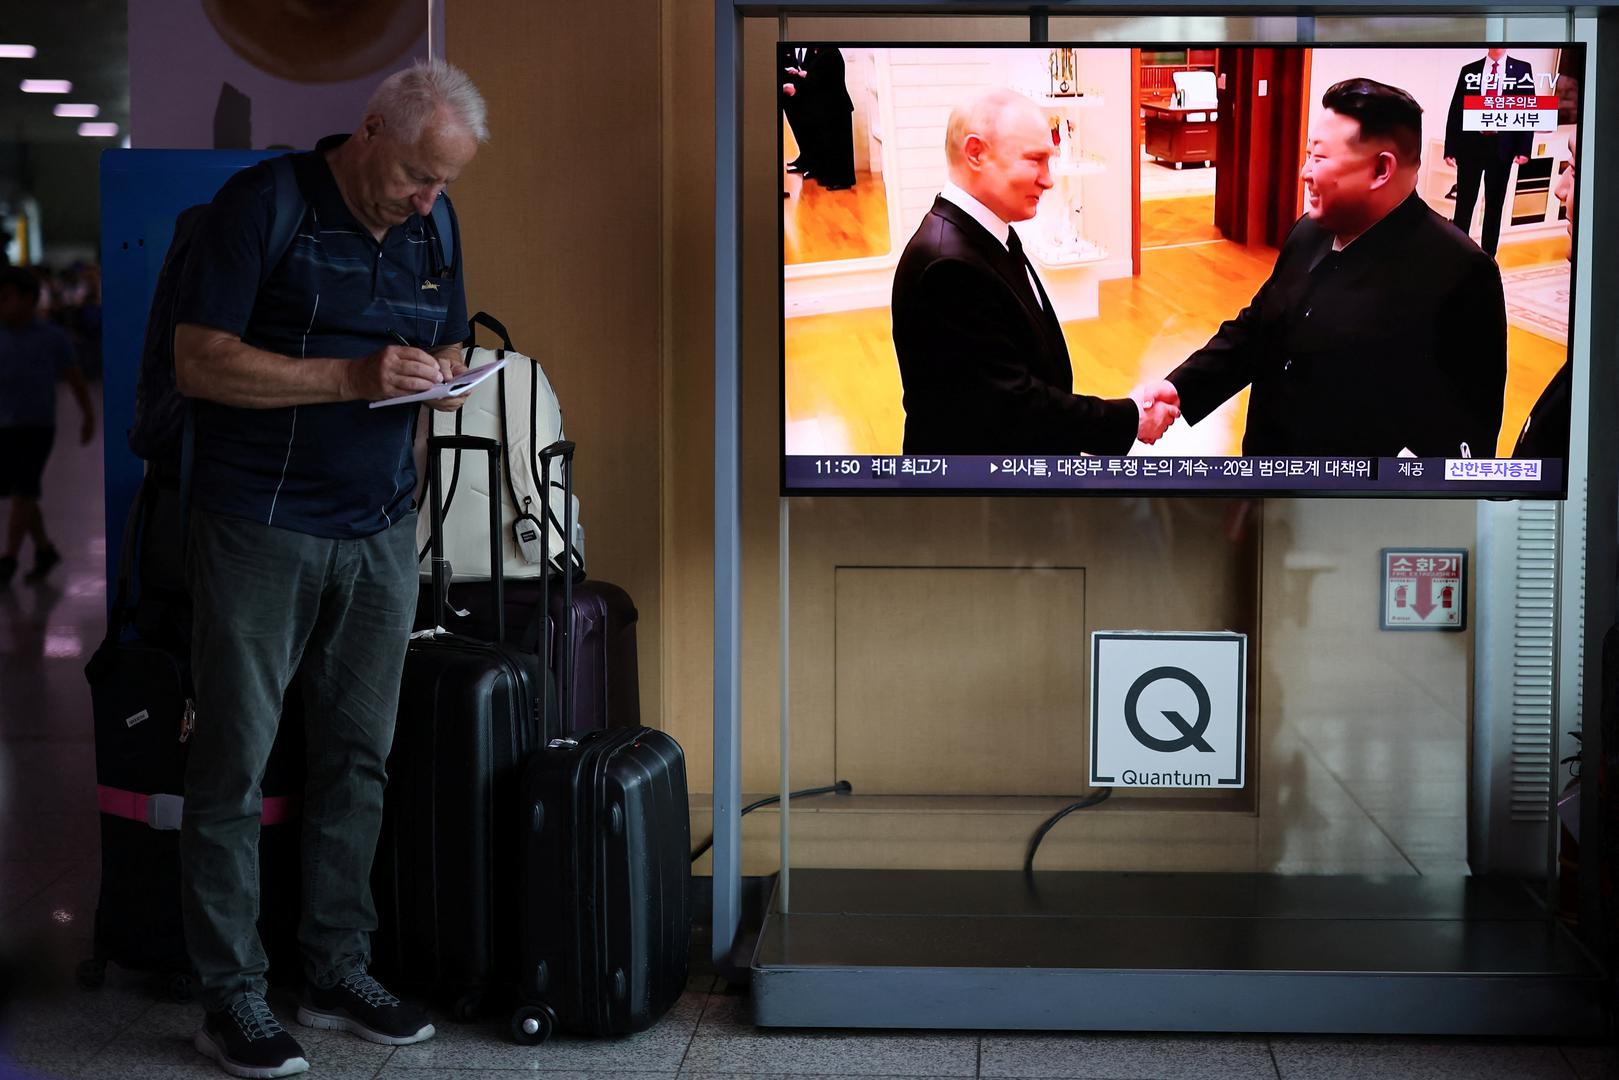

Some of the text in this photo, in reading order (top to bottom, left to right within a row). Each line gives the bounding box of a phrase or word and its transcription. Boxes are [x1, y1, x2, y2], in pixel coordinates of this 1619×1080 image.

[1483, 96, 1538, 109] 폭염주의보
[1480, 113, 1540, 127] 부산 서부
[815, 459, 861, 474] 11:50
[901, 458, 948, 476] 최고가
[1001, 458, 1052, 478] 의사들,
[1057, 458, 1103, 477] 대정부
[1106, 458, 1138, 477] 투쟁
[1142, 459, 1173, 477] 논의
[1259, 459, 1320, 477] 범의료계
[1325, 459, 1371, 477] 대책위
[1398, 461, 1425, 477] 제공
[1450, 461, 1538, 477] 신한투자증권
[1391, 557, 1457, 571] 소화기
[1124, 666, 1216, 753] Q
[1122, 769, 1211, 786] Quantum
